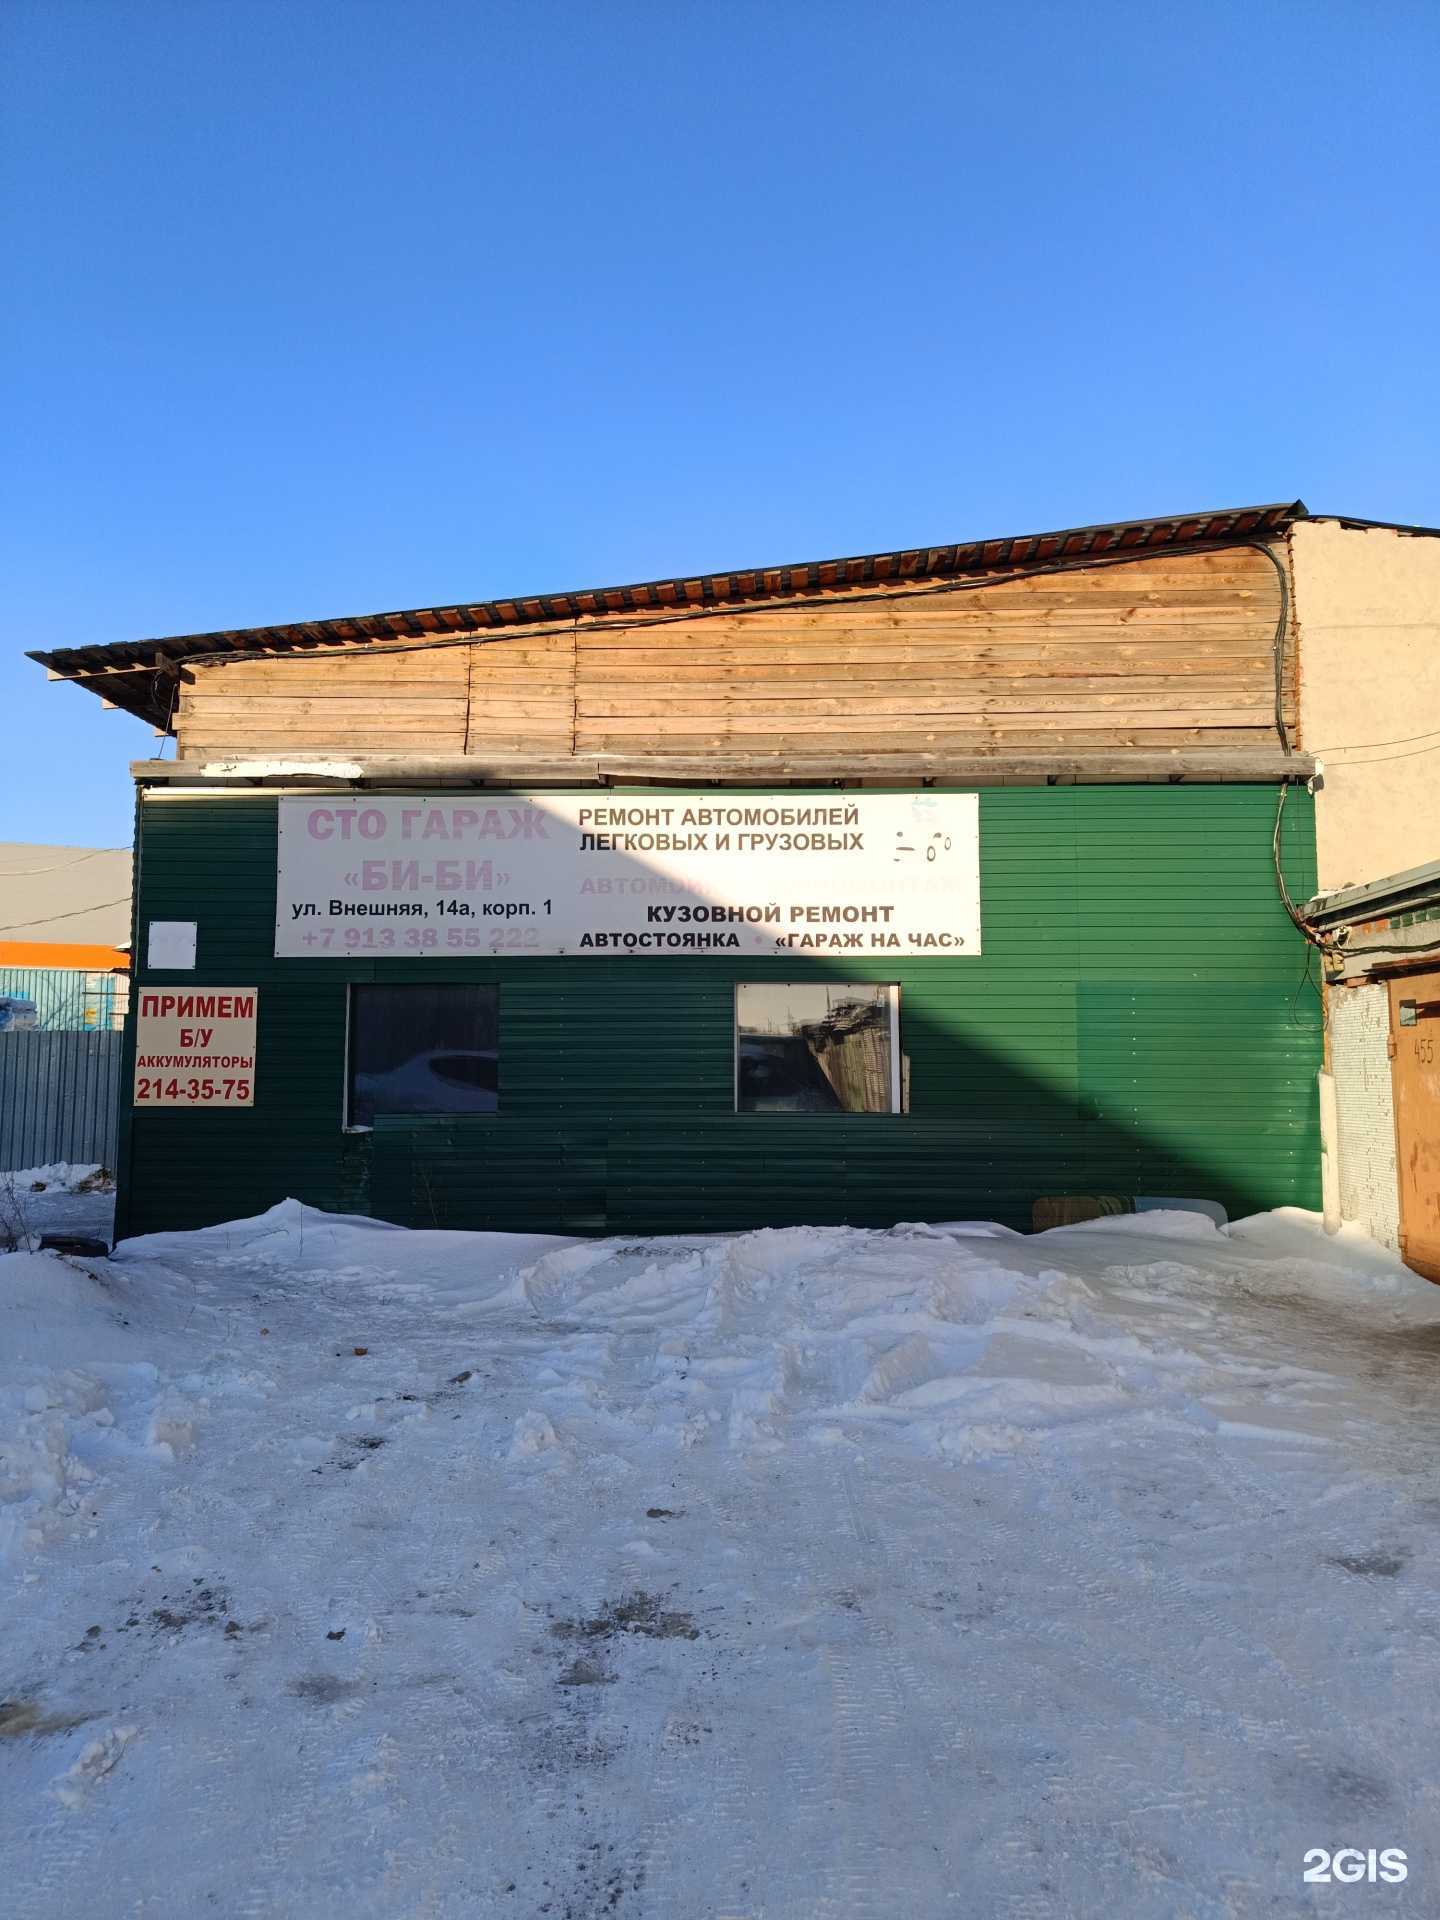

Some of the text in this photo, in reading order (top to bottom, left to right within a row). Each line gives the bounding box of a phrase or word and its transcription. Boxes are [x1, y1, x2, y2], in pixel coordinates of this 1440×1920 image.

[307, 808, 552, 841] СТО ГАРАЖ
[579, 804, 860, 826] РЕМОНТ АВТОМОБИЛЕЙ
[579, 832, 865, 851] ЛЕГКОВЫХ И ГРУЗОВЫХ
[344, 860, 511, 891] «БИ-БИ»
[292, 900, 552, 919] ул. Внешняя, 14а, корп. 1
[647, 902, 894, 923] КУЗОВНОЙ РЕМОНТ
[302, 928, 336, 948] +7
[344, 928, 396, 948] 913
[404, 928, 438, 948] 38
[447, 928, 481, 948] 55
[580, 932, 965, 948] АВТОСТОЯНКА «ГАРАЖ НА ЧАС»
[141, 995, 254, 1018] ПРИМЕМ
[179, 1028, 214, 1048] Б/У
[137, 1055, 253, 1069] АККУМУЛЯТОРЫ
[137, 1078, 250, 1100] 214-35-75
